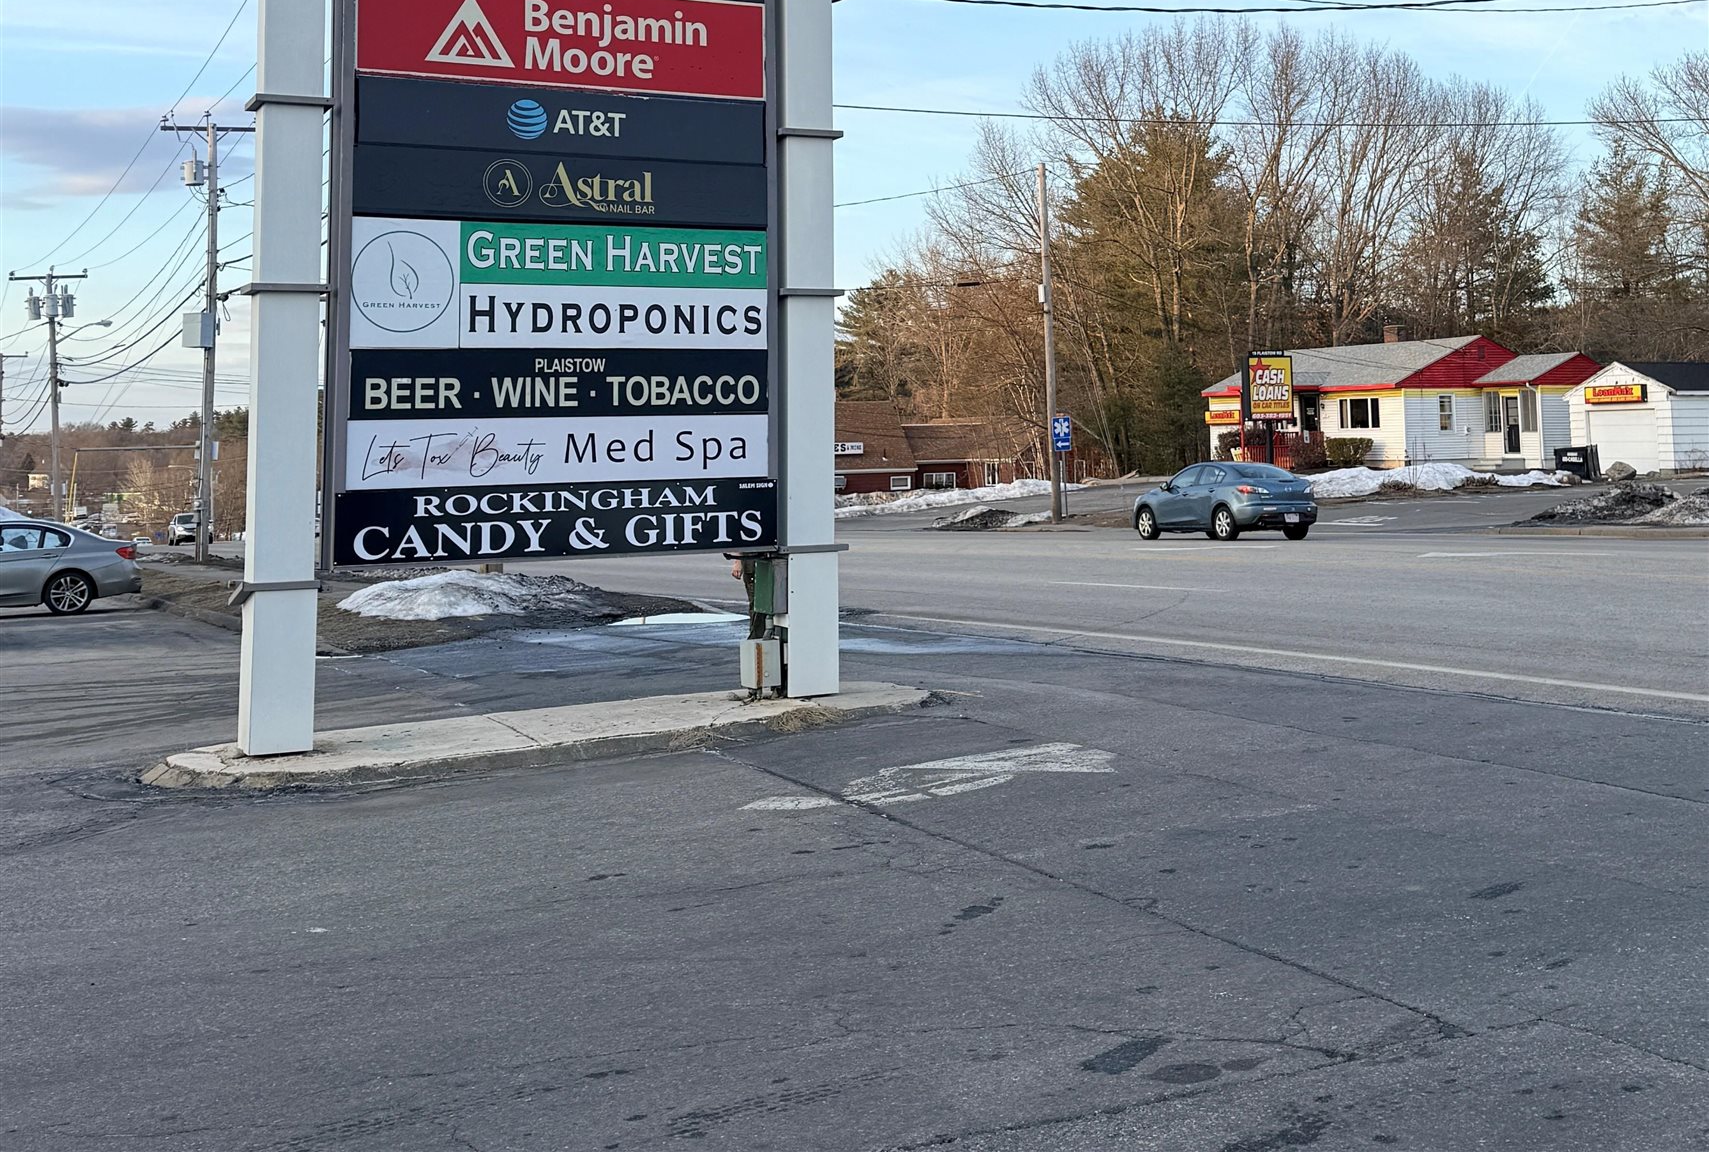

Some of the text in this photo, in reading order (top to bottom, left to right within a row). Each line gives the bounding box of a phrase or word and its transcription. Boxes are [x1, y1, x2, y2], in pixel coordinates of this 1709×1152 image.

[524, 36, 655, 79] Moore
[553, 109, 626, 137] AT&T
[539, 161, 654, 209] Astral
[610, 203, 655, 214] NAIL BAR
[466, 230, 762, 275] GREEN HARVEST
[468, 295, 762, 335] HYDROPONICS
[535, 358, 605, 373] PLAISTOW
[1255, 369, 1285, 384] CASH
[364, 375, 760, 410] BEER WINE TOBACCO
[1253, 385, 1289, 401] LOANS
[362, 429, 748, 481] Lets Tox Beauty Med Spa
[413, 485, 717, 517] ROCKINGHAM
[353, 510, 763, 561] CANDY & GIFTS
